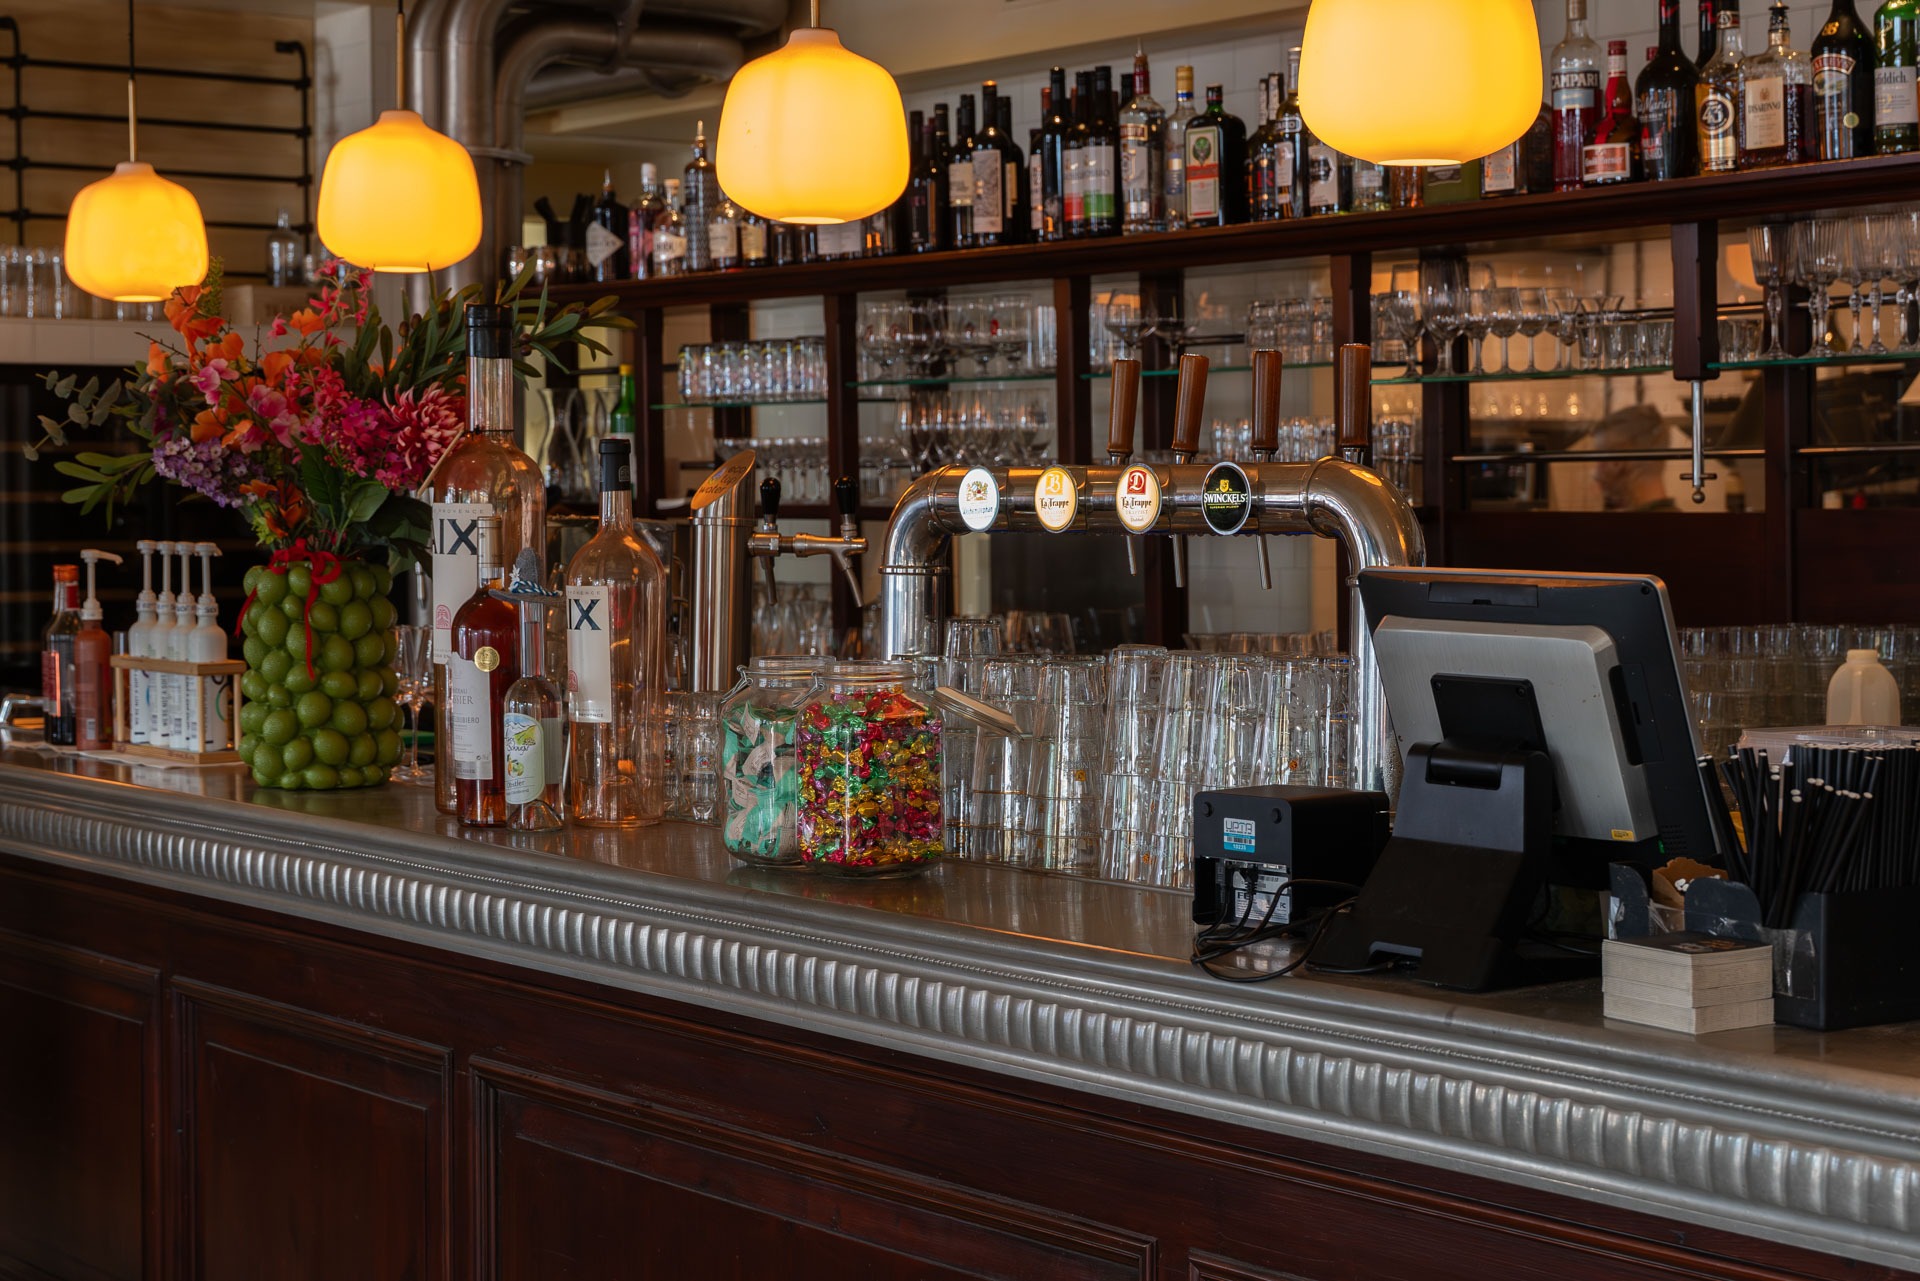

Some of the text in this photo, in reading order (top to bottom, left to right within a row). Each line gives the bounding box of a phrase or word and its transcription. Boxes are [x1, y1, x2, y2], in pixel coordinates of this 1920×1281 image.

[1039, 496, 1069, 510] La Trappe
[1120, 496, 1152, 509] La Trappe
